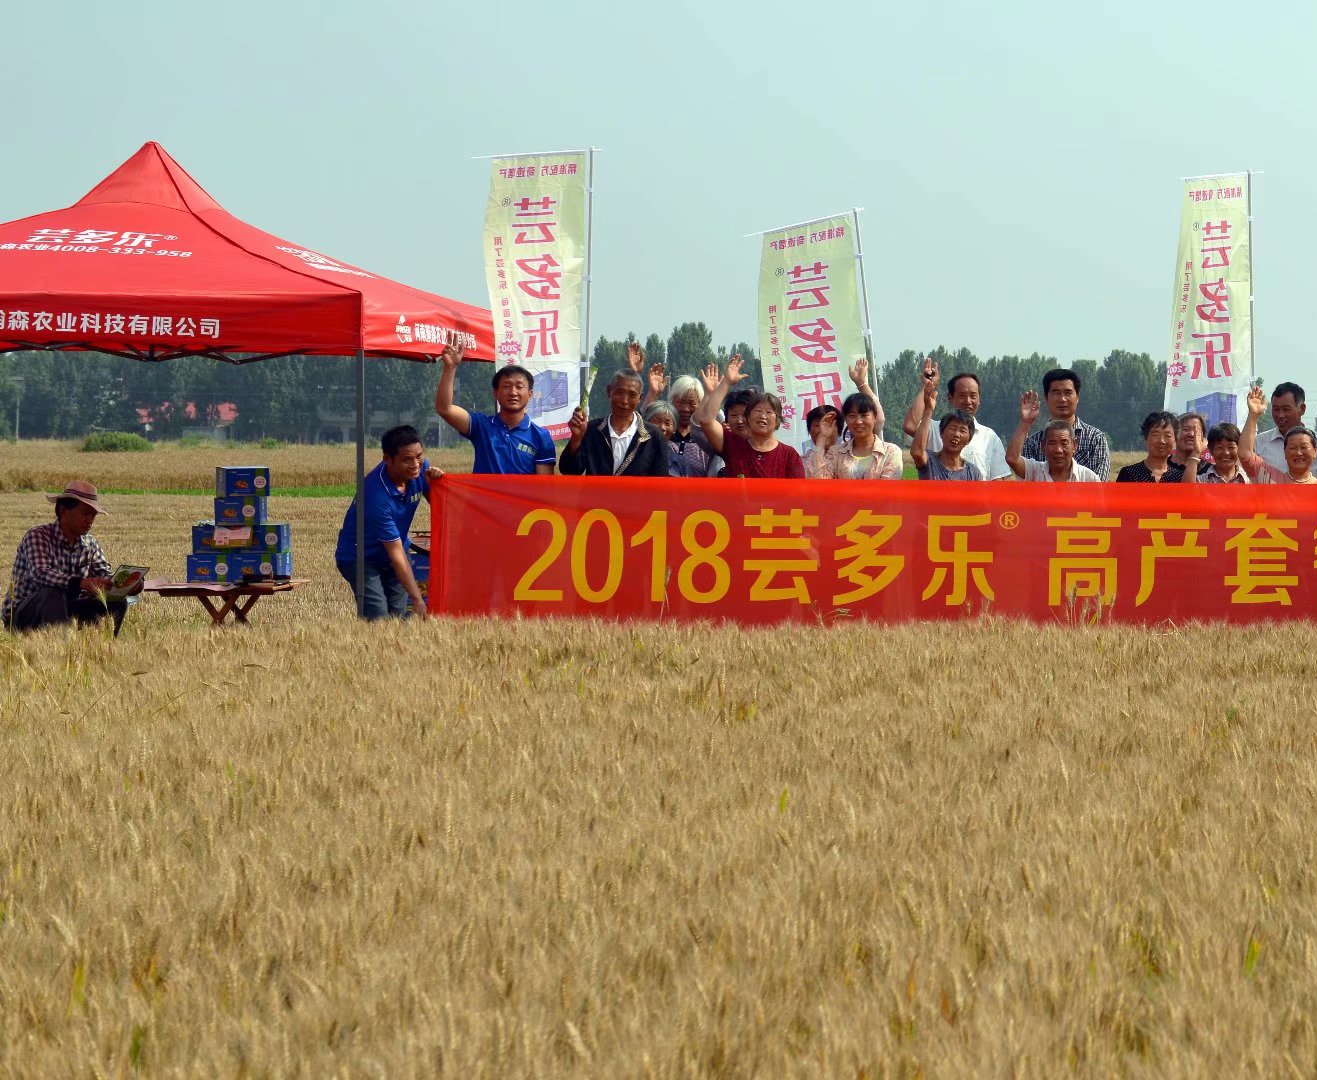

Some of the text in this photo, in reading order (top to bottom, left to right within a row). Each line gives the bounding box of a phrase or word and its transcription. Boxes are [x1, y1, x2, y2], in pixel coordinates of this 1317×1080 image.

[0, 309, 220, 339] 森农业科技有限公司
